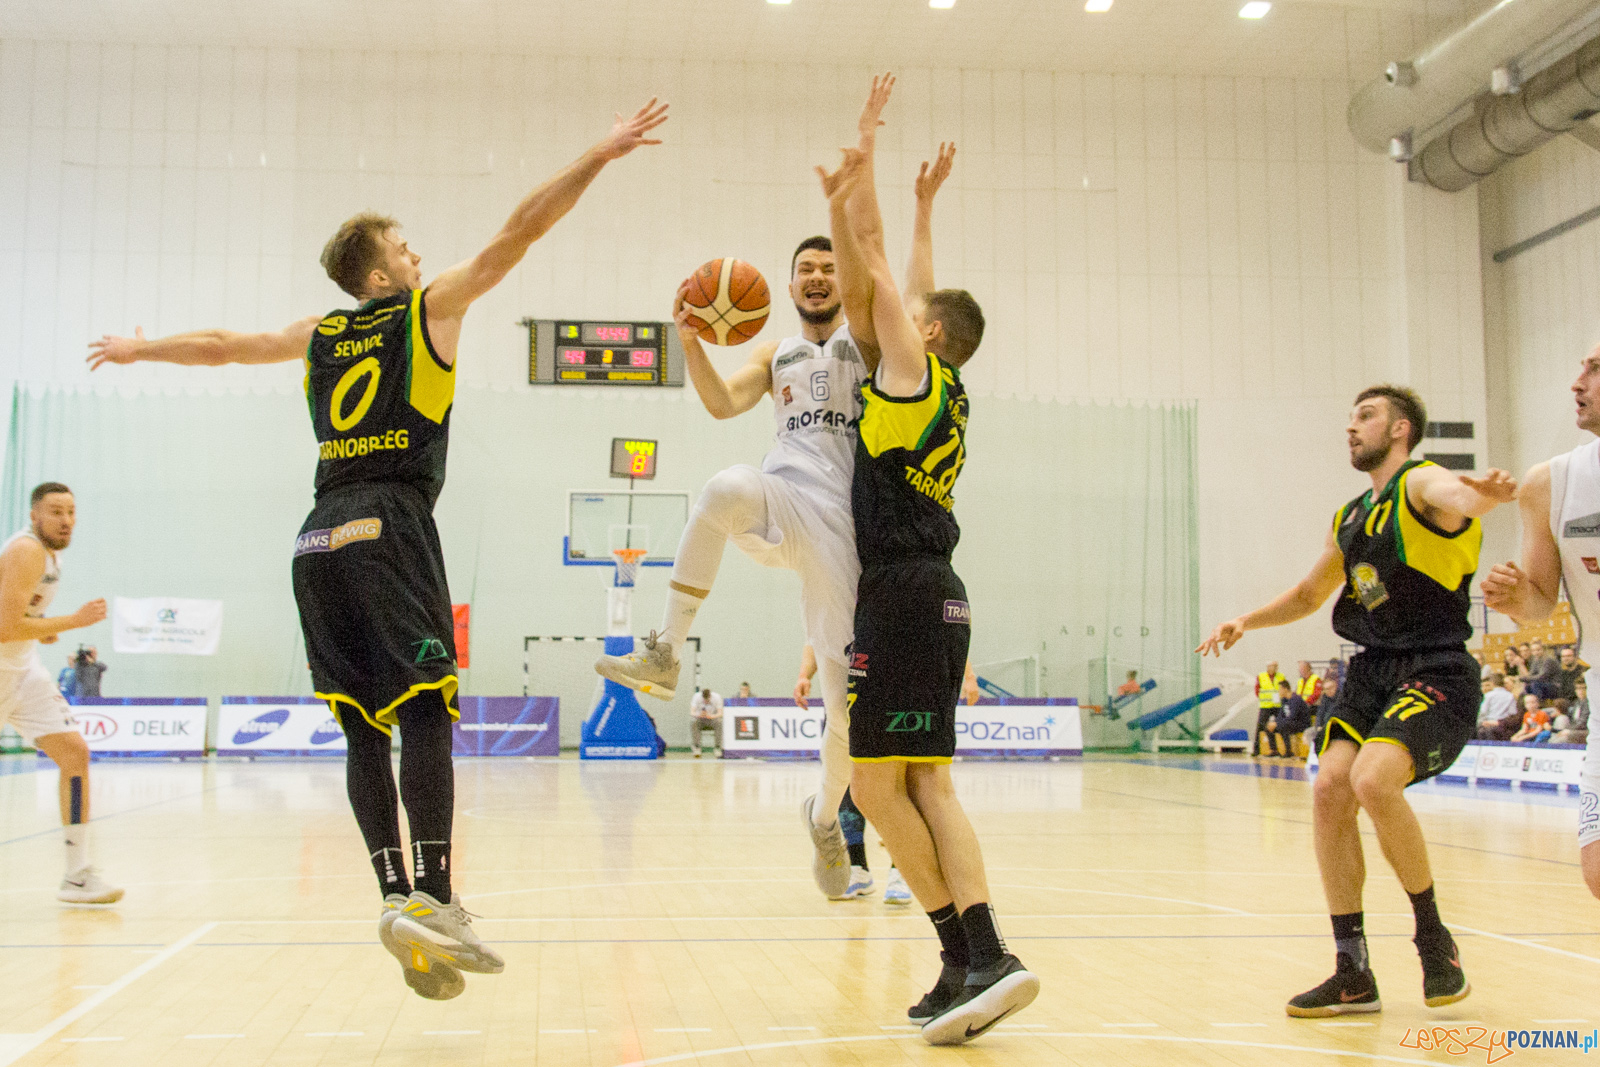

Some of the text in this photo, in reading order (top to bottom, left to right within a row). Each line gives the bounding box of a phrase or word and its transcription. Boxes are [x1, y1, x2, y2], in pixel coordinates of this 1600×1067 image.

[602, 349, 614, 364] 3
[631, 350, 654, 367] 50
[330, 356, 382, 432] 0
[810, 370, 830, 402] 6
[631, 455, 647, 474] 8
[133, 720, 190, 736] DELIK
[885, 711, 937, 732] ZOT
